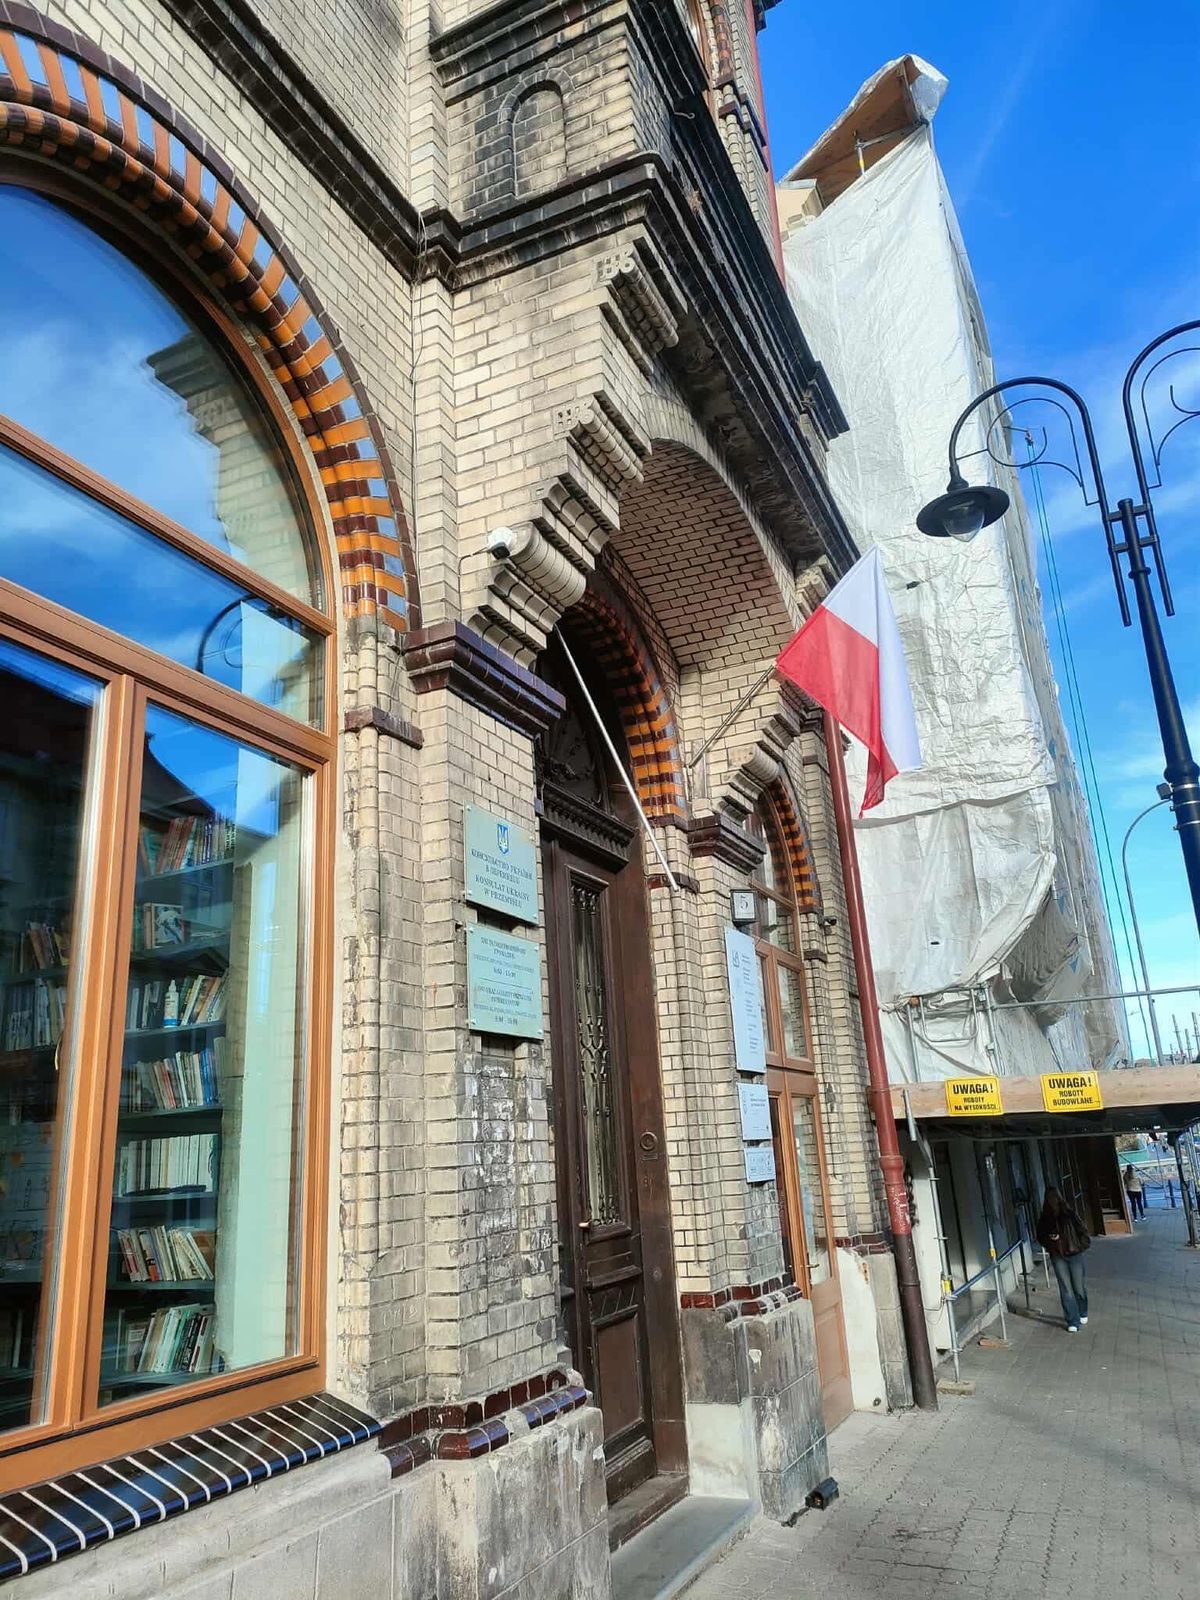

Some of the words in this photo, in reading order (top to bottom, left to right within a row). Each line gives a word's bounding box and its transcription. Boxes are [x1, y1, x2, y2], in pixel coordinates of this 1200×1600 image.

[475, 874, 505, 892] KONSULAT
[740, 894, 749, 910] 5
[1059, 1090, 1084, 1098] ROBOTY
[1052, 1097, 1094, 1106] BUDOWLANE
